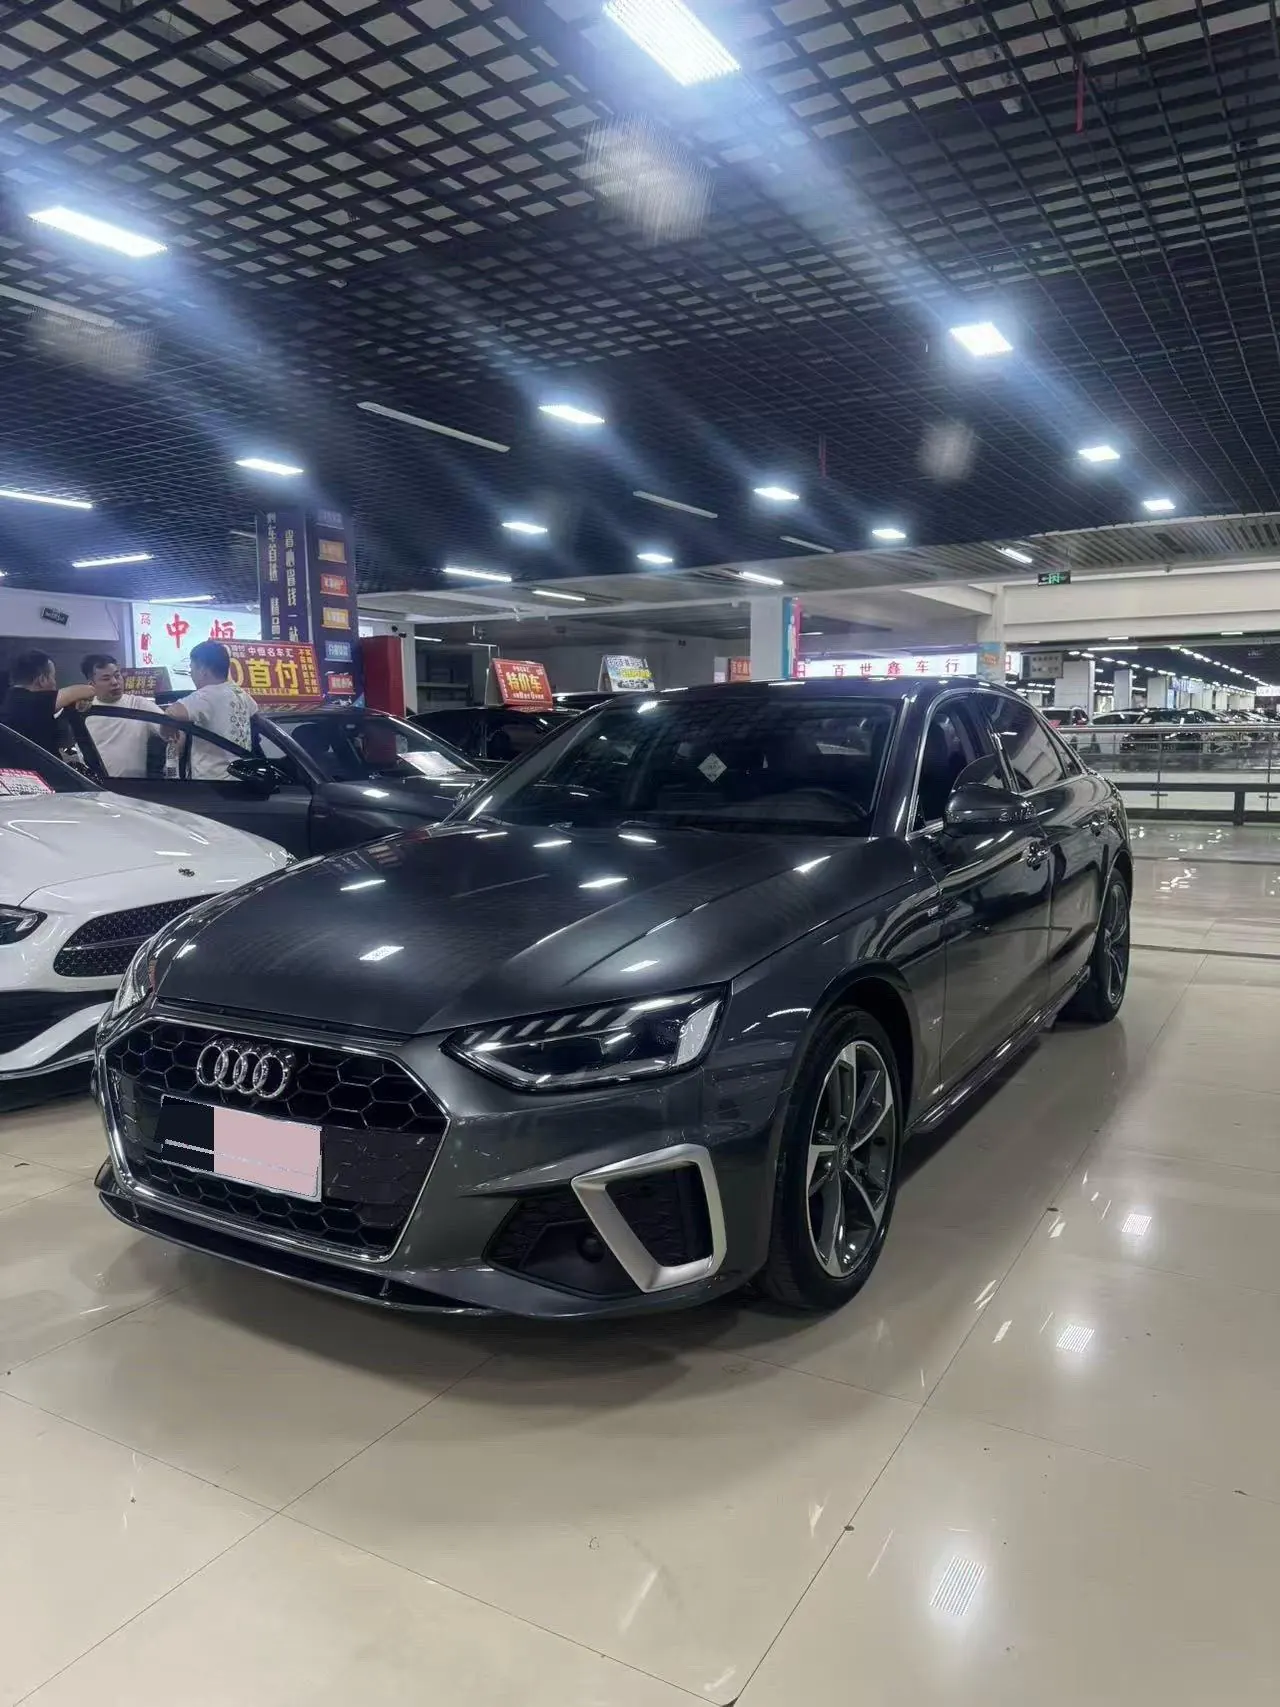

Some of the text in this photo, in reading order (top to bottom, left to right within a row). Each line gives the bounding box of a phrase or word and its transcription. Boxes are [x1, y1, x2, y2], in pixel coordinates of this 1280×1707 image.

[833, 659, 961, 681] 百世鑫车行
[505, 671, 543, 693] 特价车
